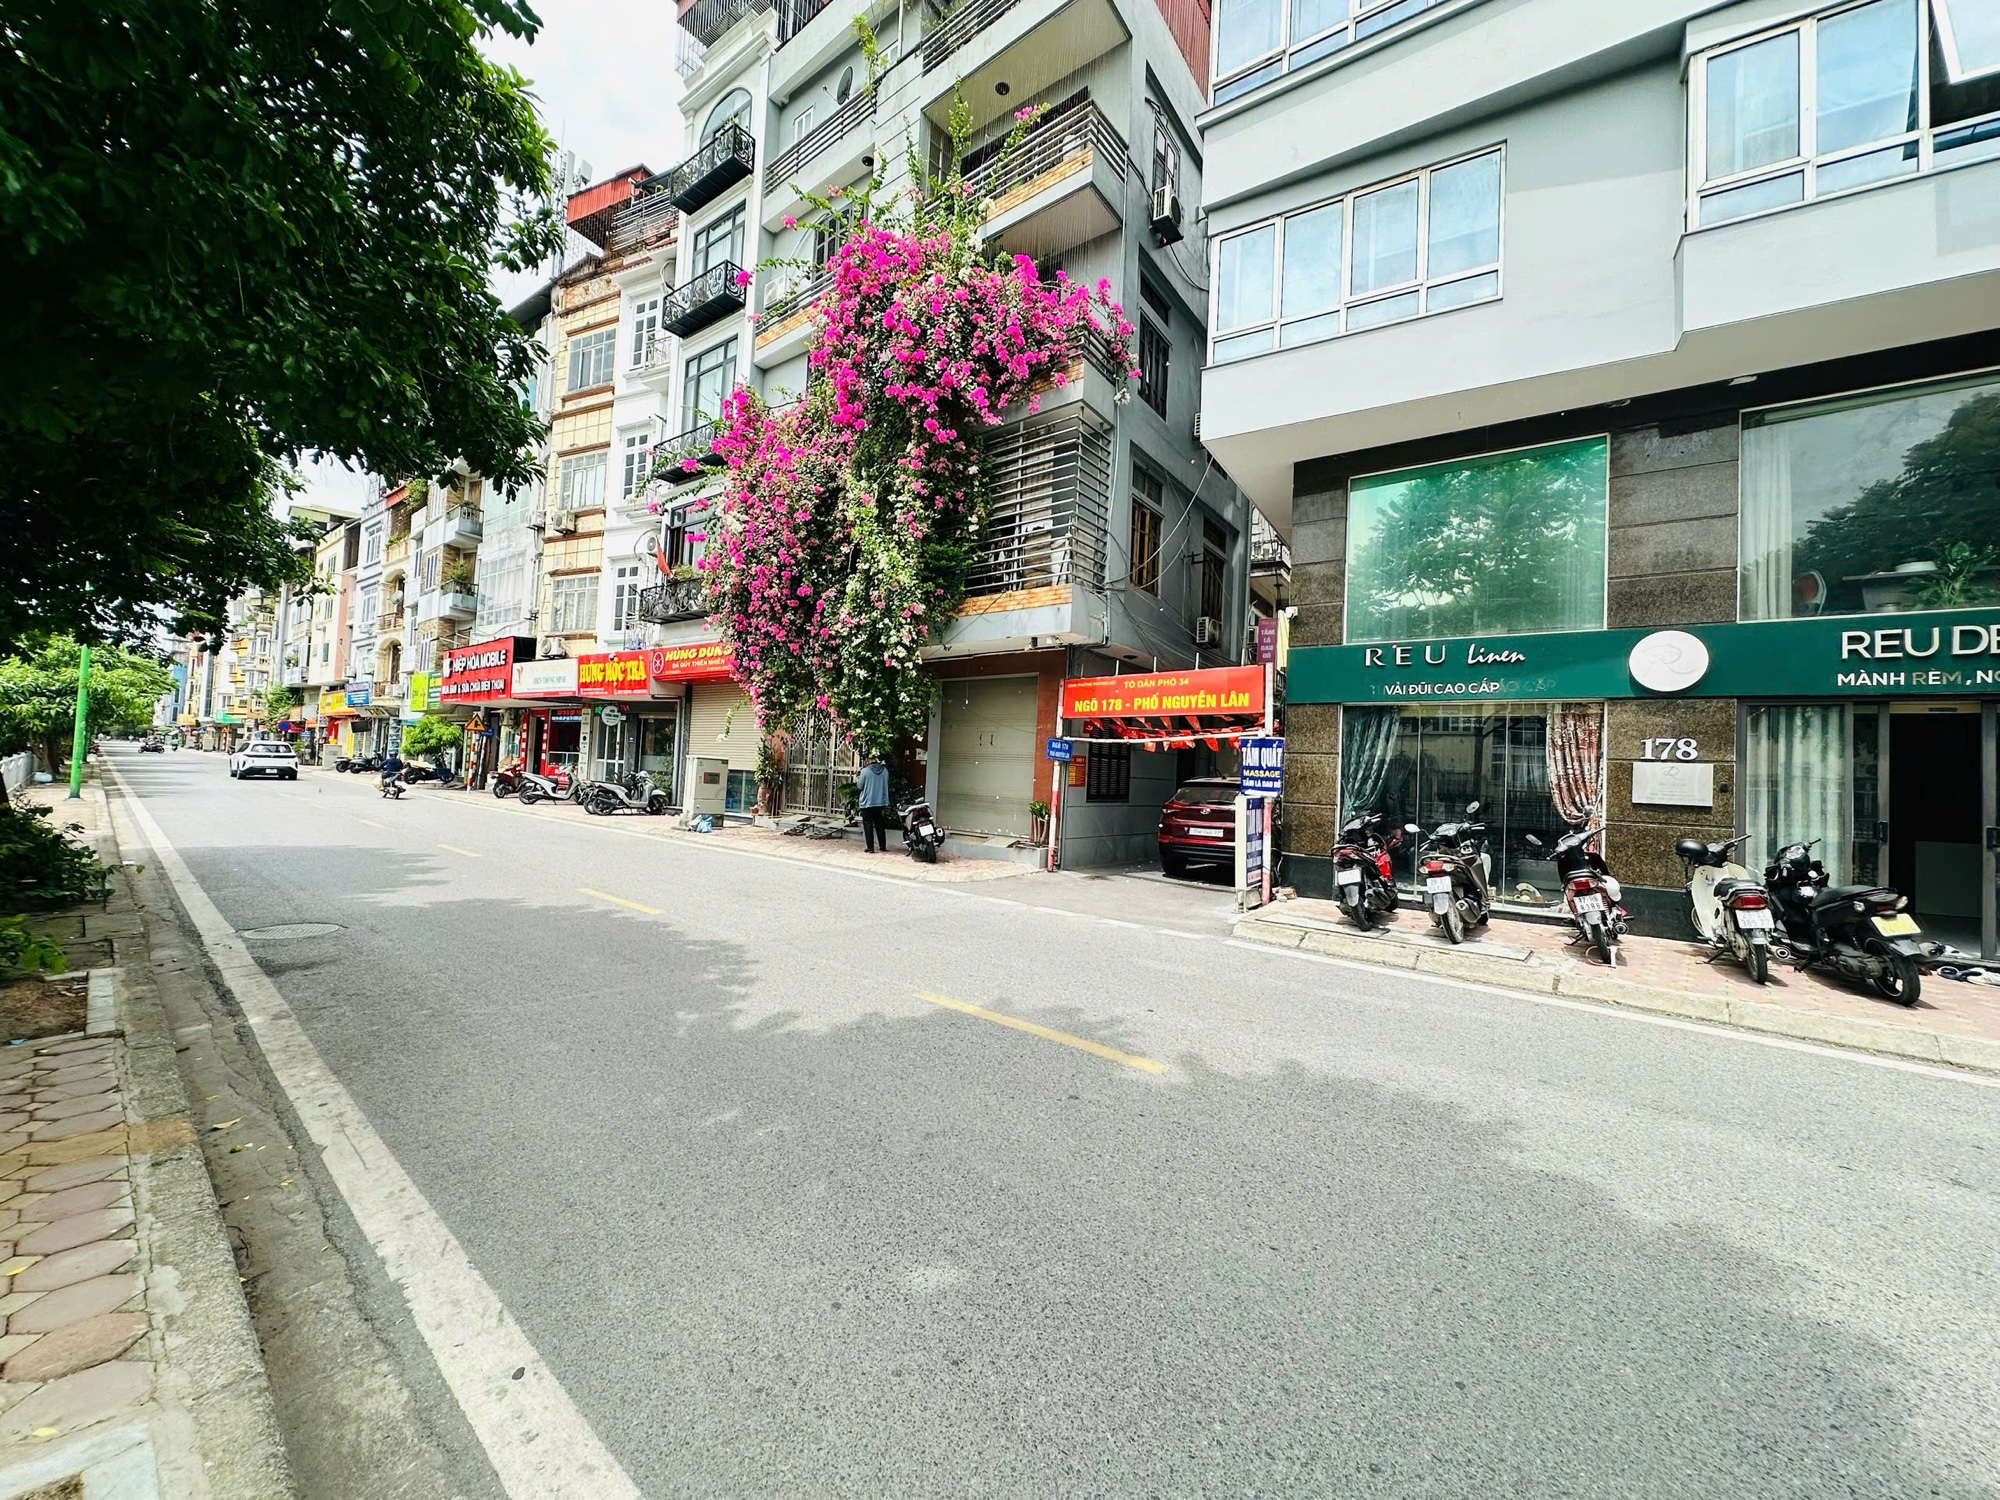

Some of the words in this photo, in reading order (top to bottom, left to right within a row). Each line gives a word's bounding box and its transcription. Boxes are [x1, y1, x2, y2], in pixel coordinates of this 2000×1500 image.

[1841, 627, 1940, 660] REU
[480, 649, 506, 669] MOBILE
[665, 647, 698, 661] HÙNG
[1138, 679, 1155, 688] DÂN
[1178, 677, 1189, 686] 34
[1434, 683, 1466, 694] CAO
[1468, 677, 1500, 694] CẤP
[1074, 699, 1098, 712] NGÕ
[1101, 698, 1123, 711] 178
[1133, 692, 1160, 710] PHỐ
[1162, 690, 1216, 708] NGUYỄN
[1220, 692, 1249, 707] LÂN
[1640, 737, 1698, 761] 178
[1243, 769, 1281, 778] MASSAGE
